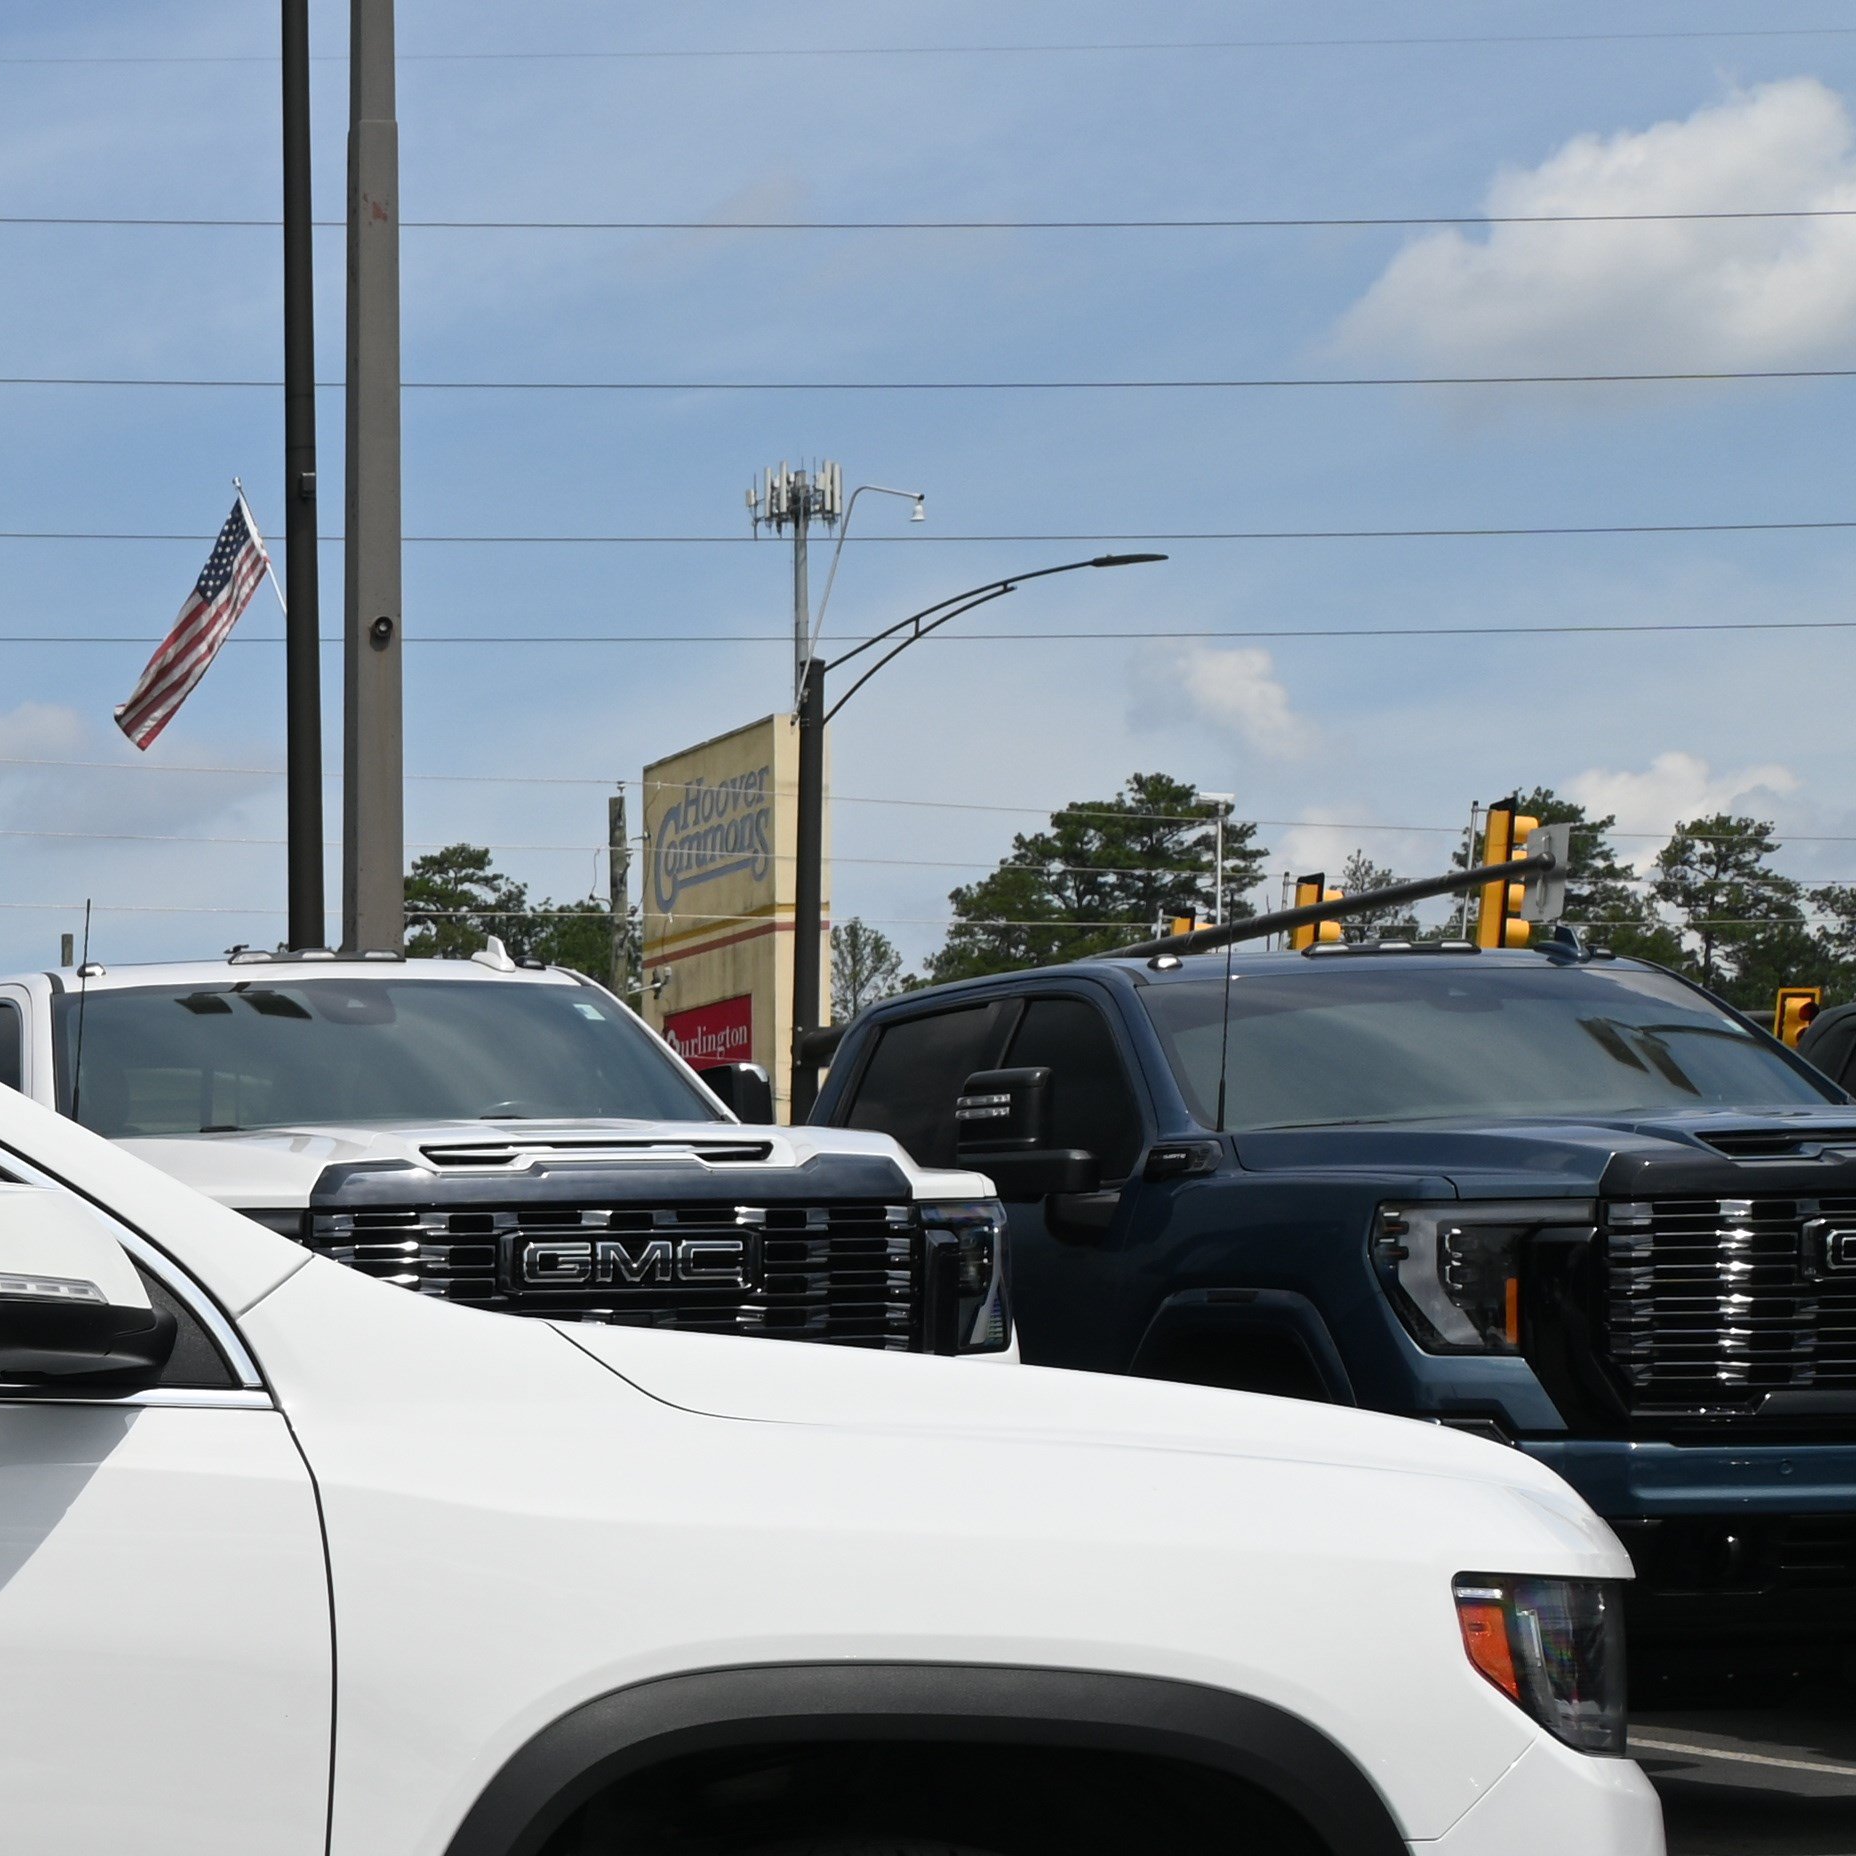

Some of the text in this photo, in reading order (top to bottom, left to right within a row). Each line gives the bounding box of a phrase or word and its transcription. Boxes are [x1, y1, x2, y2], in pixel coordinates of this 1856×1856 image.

[681, 764, 770, 831] Hoover
[654, 802, 770, 913] Commons
[522, 1240, 744, 1284] GMC
